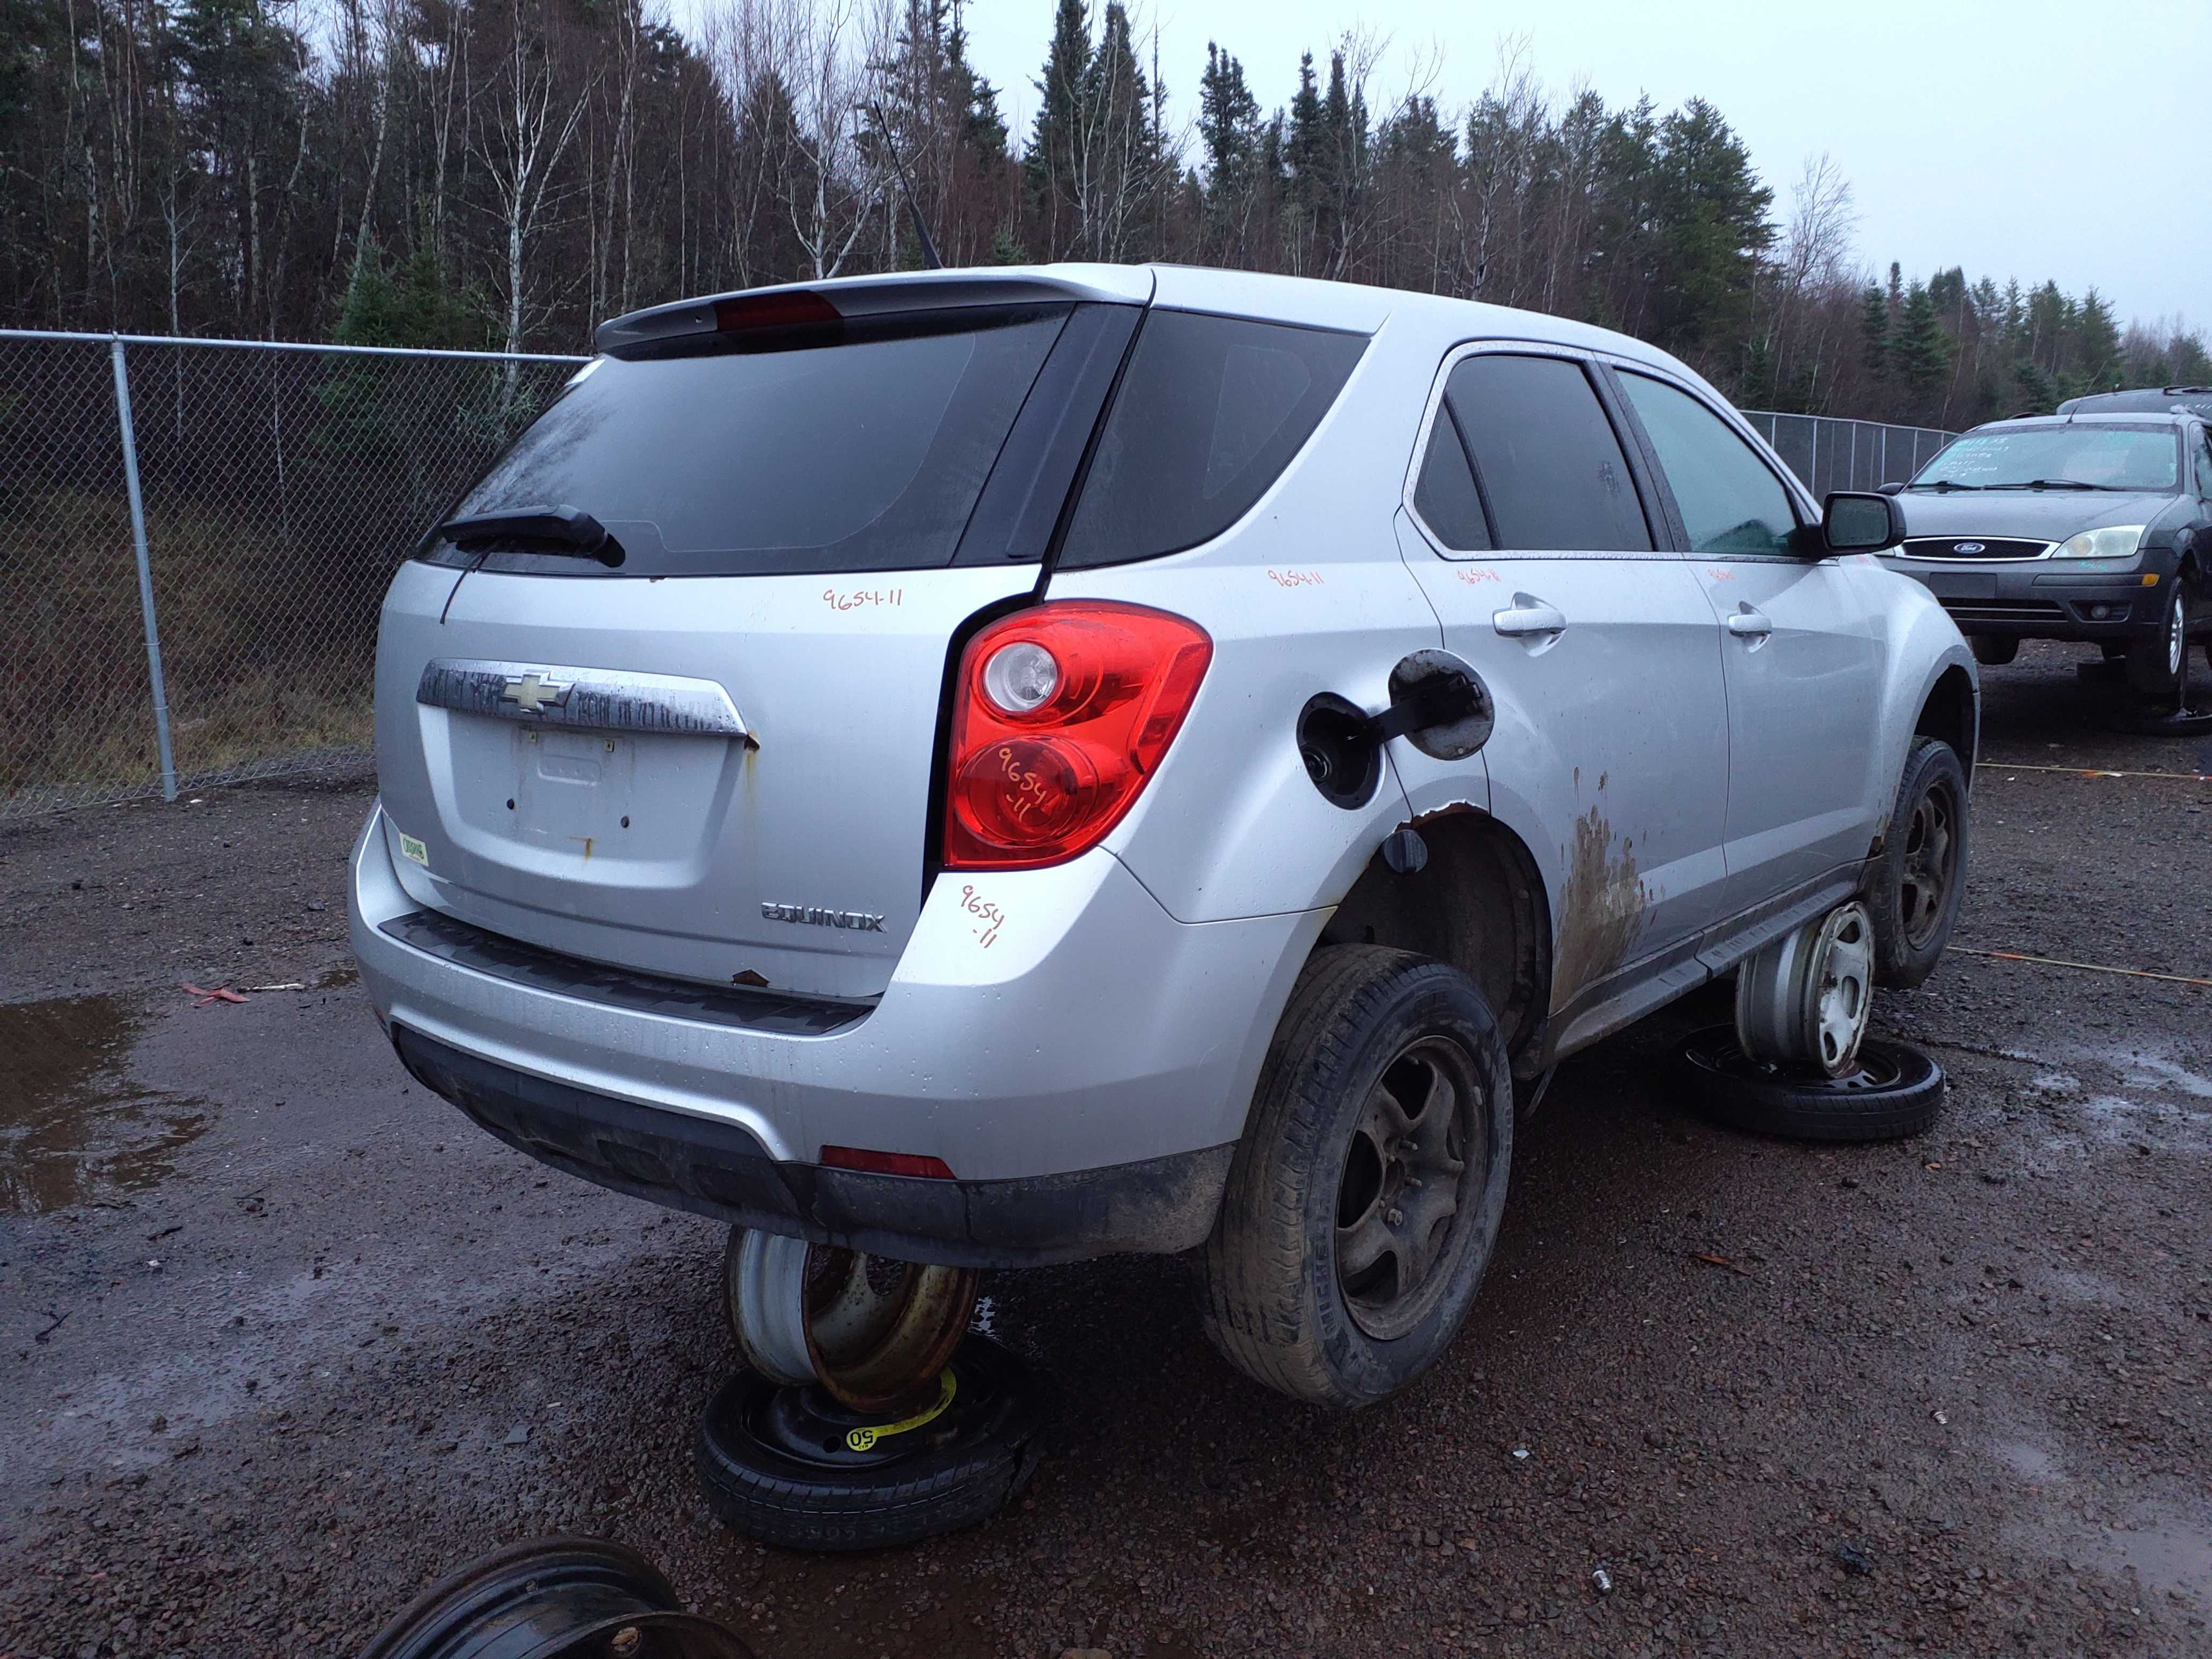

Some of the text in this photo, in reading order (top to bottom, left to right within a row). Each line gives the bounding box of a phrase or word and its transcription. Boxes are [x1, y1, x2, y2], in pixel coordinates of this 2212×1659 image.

[823, 589, 902, 610] 9654-11
[998, 748, 1047, 804] 9654
[761, 902, 887, 933] EQUINOX
[960, 885, 1005, 930] 9654
[850, 1430, 873, 1446] 50
